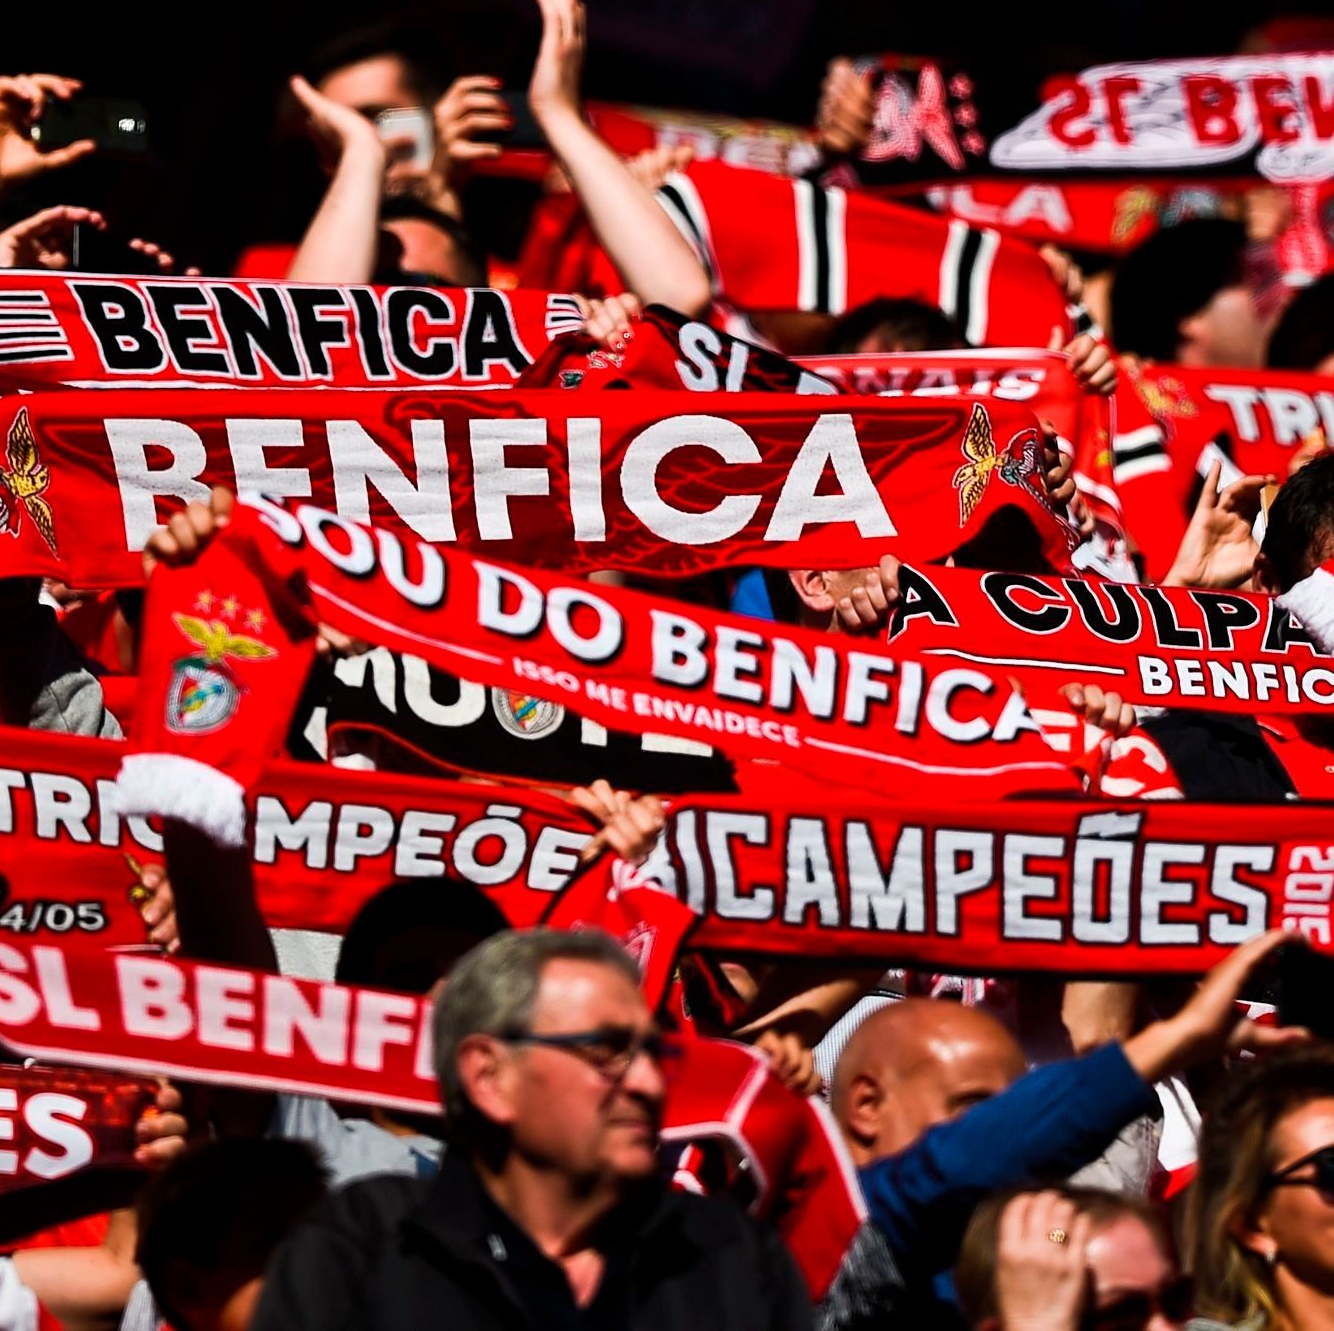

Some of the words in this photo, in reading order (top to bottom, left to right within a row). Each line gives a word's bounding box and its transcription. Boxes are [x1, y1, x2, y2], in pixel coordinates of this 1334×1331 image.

[66, 279, 534, 382] BENFICA
[104, 413, 899, 552] BENFICA
[473, 560, 624, 661] DO
[512, 658, 580, 694] ISSO
[586, 677, 629, 711] ME
[632, 690, 803, 749] ENVAIDECE
